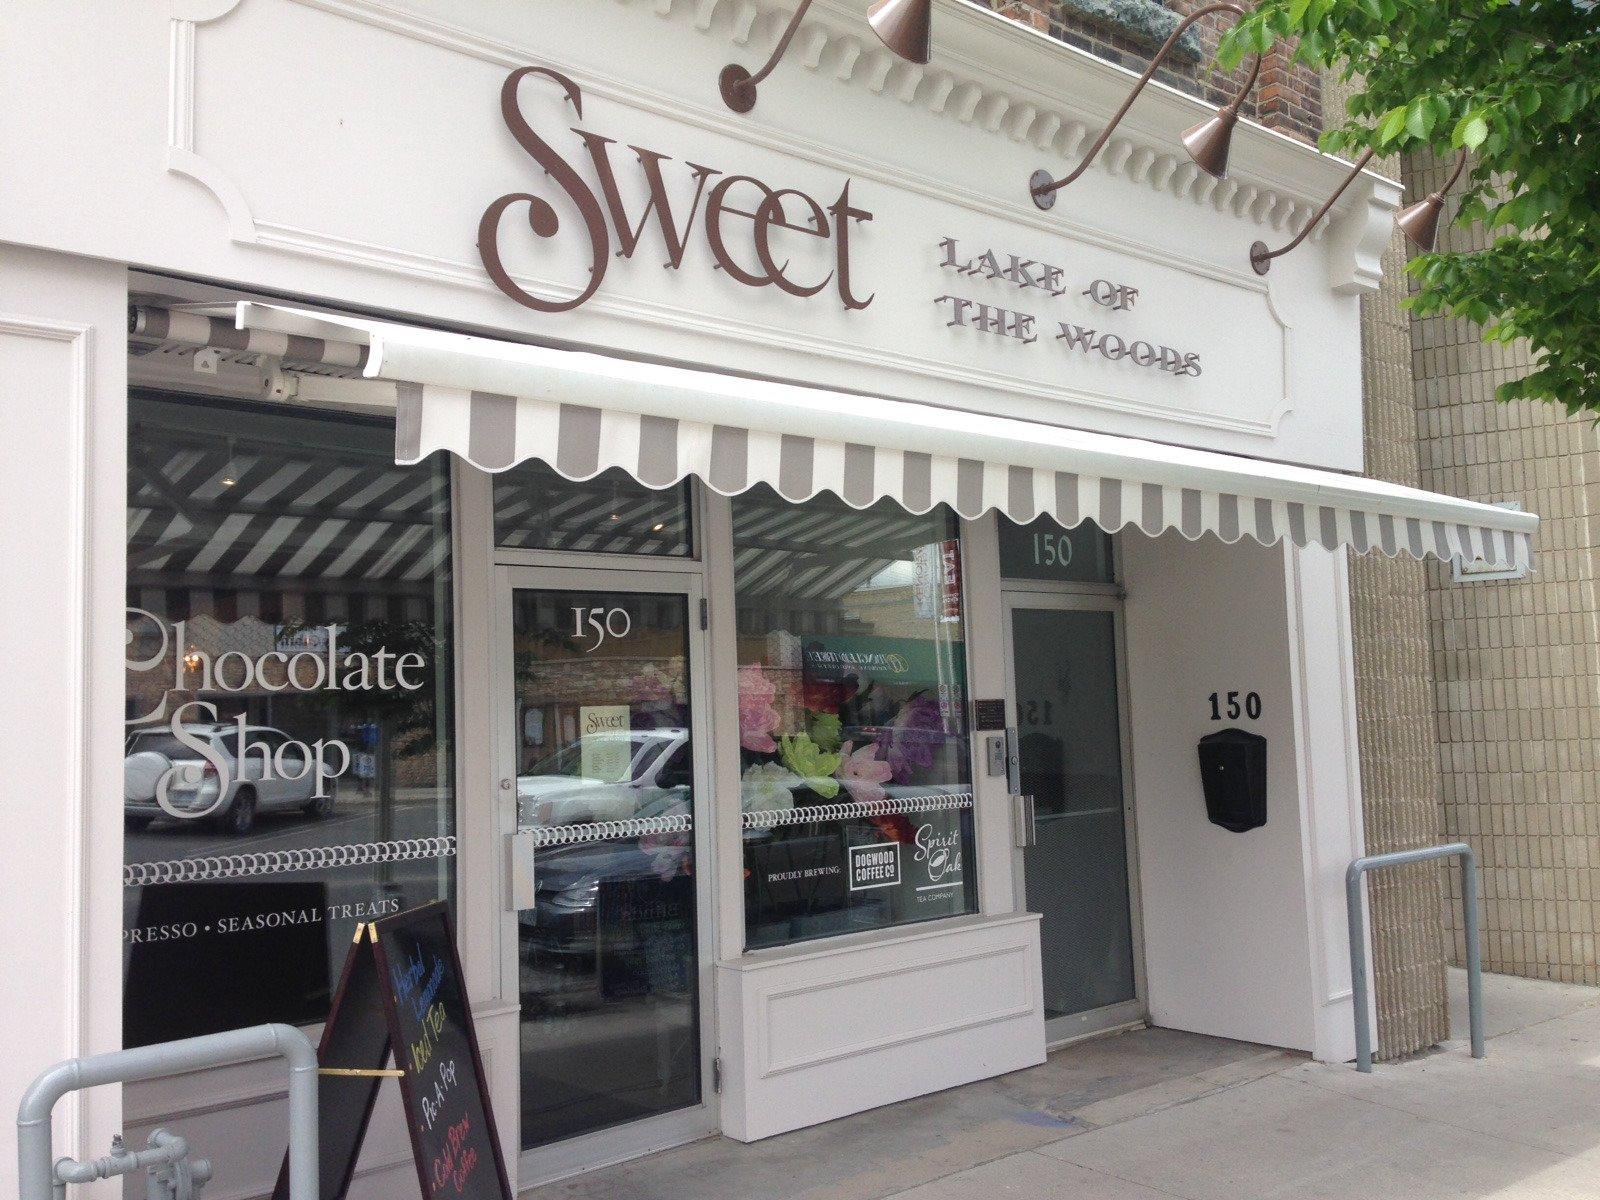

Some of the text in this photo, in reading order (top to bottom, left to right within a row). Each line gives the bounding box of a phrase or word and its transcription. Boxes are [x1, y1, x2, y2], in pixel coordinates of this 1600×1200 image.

[477, 66, 875, 313] Sweet
[939, 236, 1139, 311] LAKE OF
[934, 295, 1202, 377] THE WOODS
[1033, 533, 1072, 566] 150
[571, 607, 631, 652] 150
[586, 712, 624, 734] Sweet
[1208, 692, 1262, 720] 150
[156, 700, 350, 818] Shop
[855, 850, 894, 867] DOGWOOD
[914, 823, 959, 861] Spirit
[768, 870, 803, 882] PROUDLY
[856, 865, 884, 882] COFFEE
[916, 891, 953, 903] TEA COMPANY
[217, 908, 322, 933] SEASONAL
[328, 898, 400, 920] TREATS
